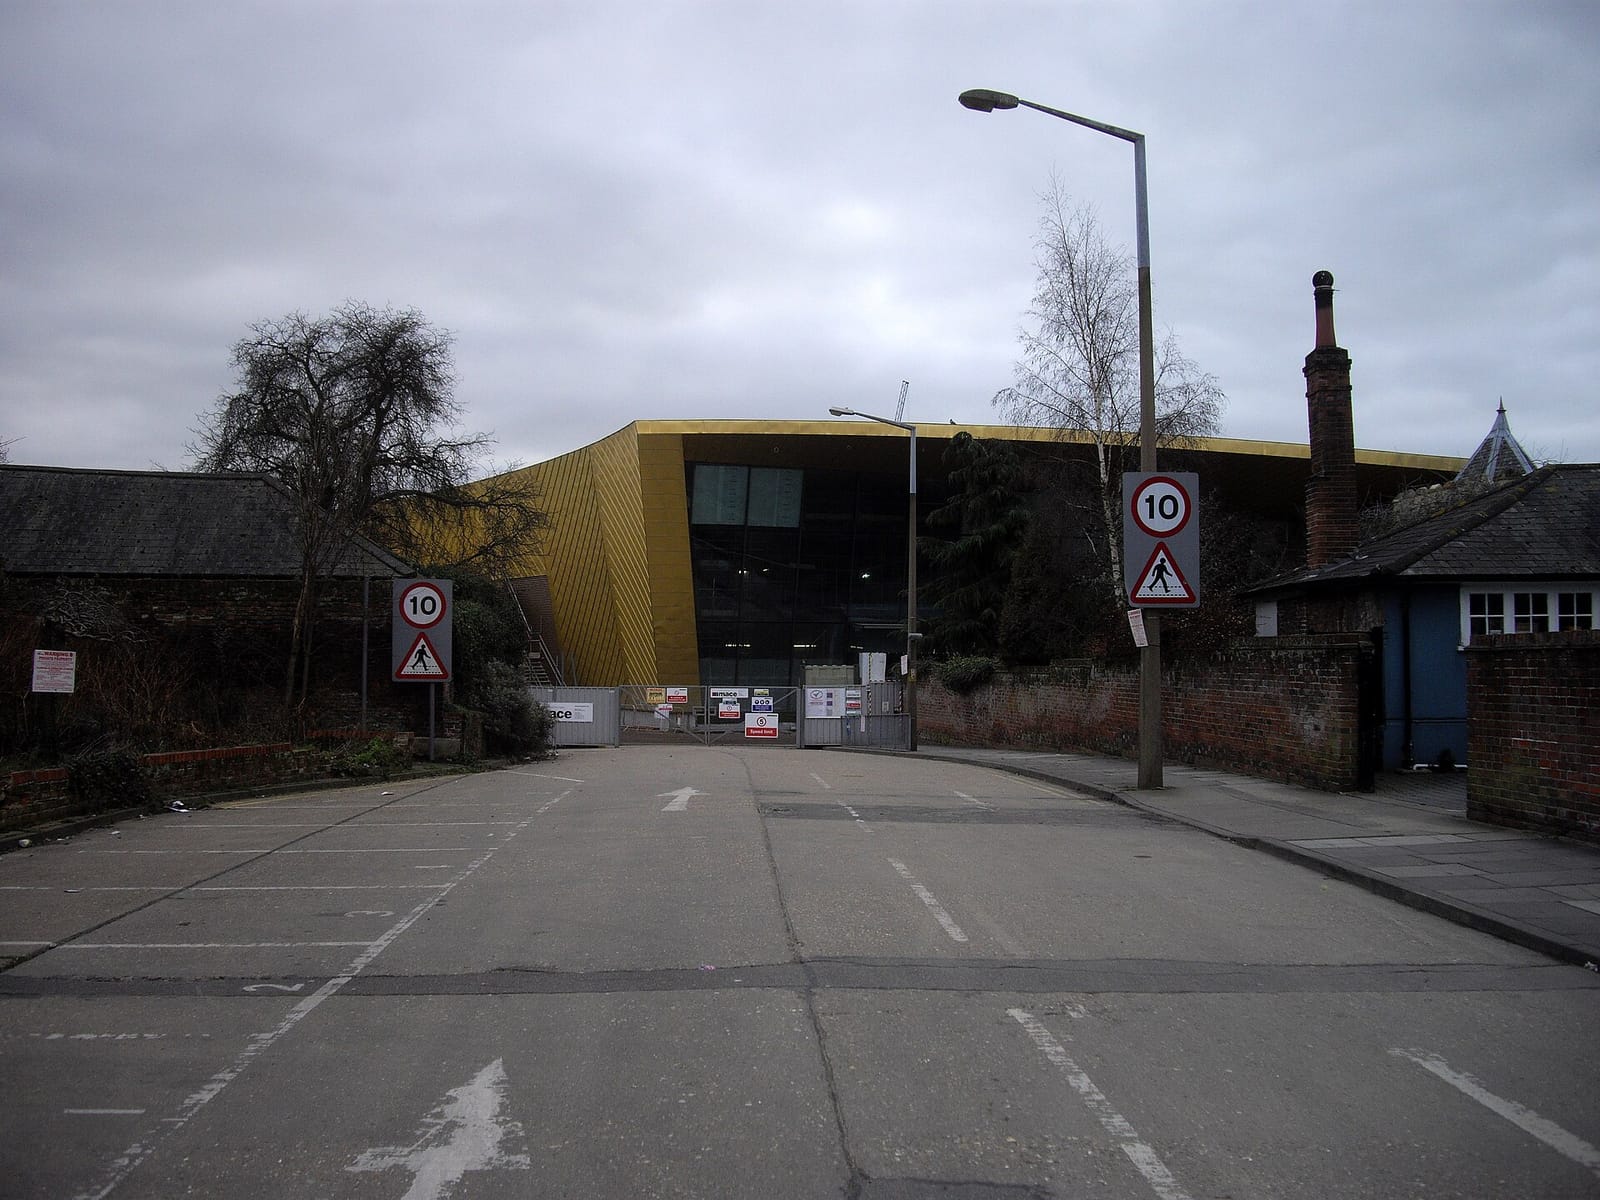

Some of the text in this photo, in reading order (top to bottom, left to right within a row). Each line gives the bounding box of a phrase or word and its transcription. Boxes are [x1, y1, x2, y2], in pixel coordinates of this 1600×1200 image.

[1145, 494, 1179, 520] 10
[409, 596, 437, 616] 10
[549, 710, 572, 719] ace
